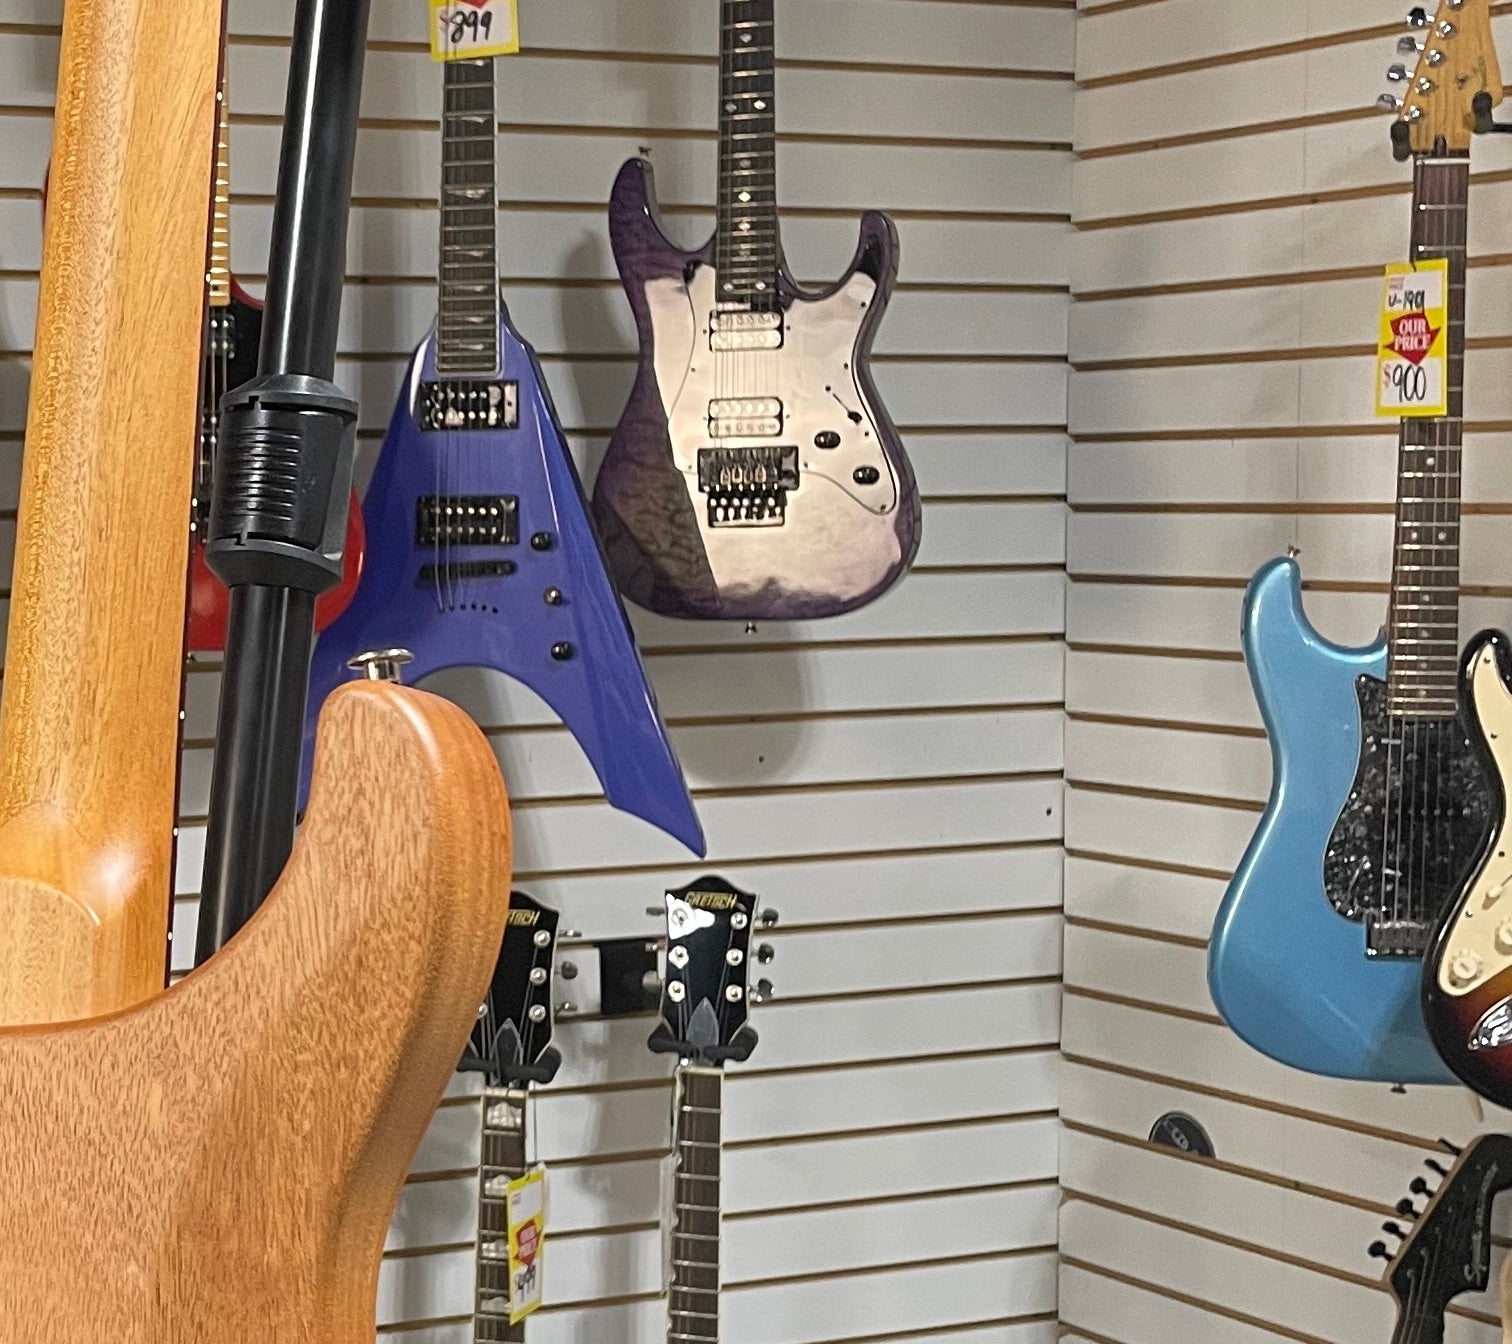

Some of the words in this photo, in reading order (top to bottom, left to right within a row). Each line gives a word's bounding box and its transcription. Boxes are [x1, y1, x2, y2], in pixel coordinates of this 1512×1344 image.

[439, 9, 493, 44] $899
[1398, 318, 1426, 336] OUR
[1394, 333, 1432, 353] PRICE
[1383, 363, 1427, 403] $900
[508, 909, 542, 927] TSCH
